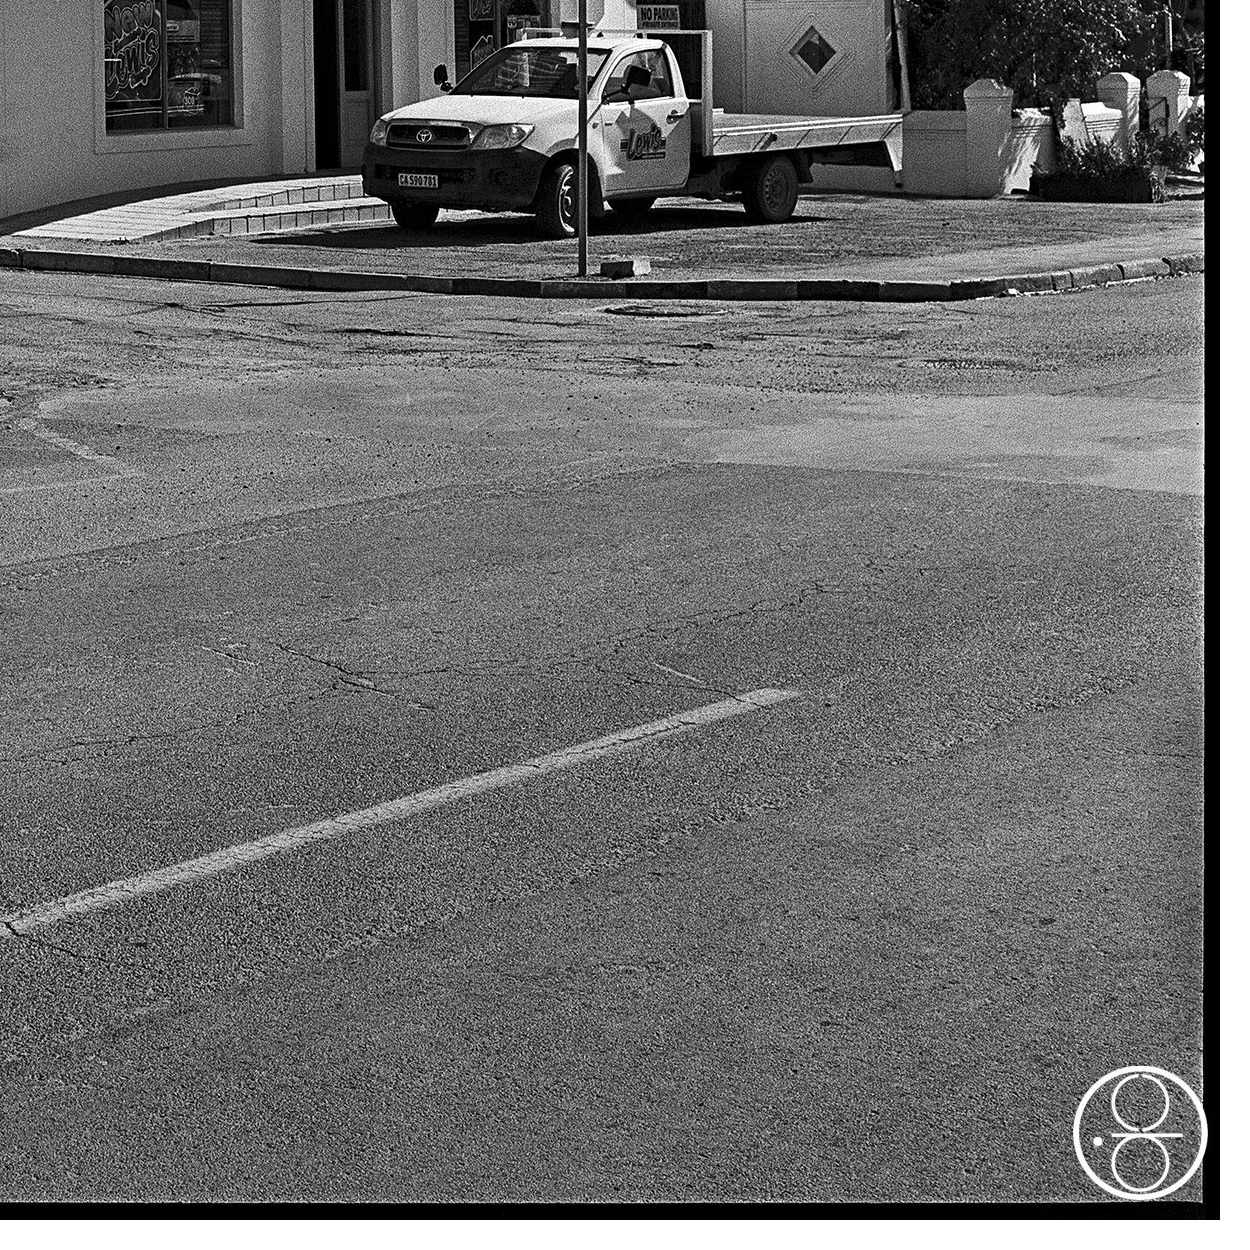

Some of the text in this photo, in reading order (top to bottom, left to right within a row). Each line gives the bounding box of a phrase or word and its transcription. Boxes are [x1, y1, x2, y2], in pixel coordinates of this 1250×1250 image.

[640, 7, 678, 21] NO PARKING
[627, 126, 661, 161] Lewis
